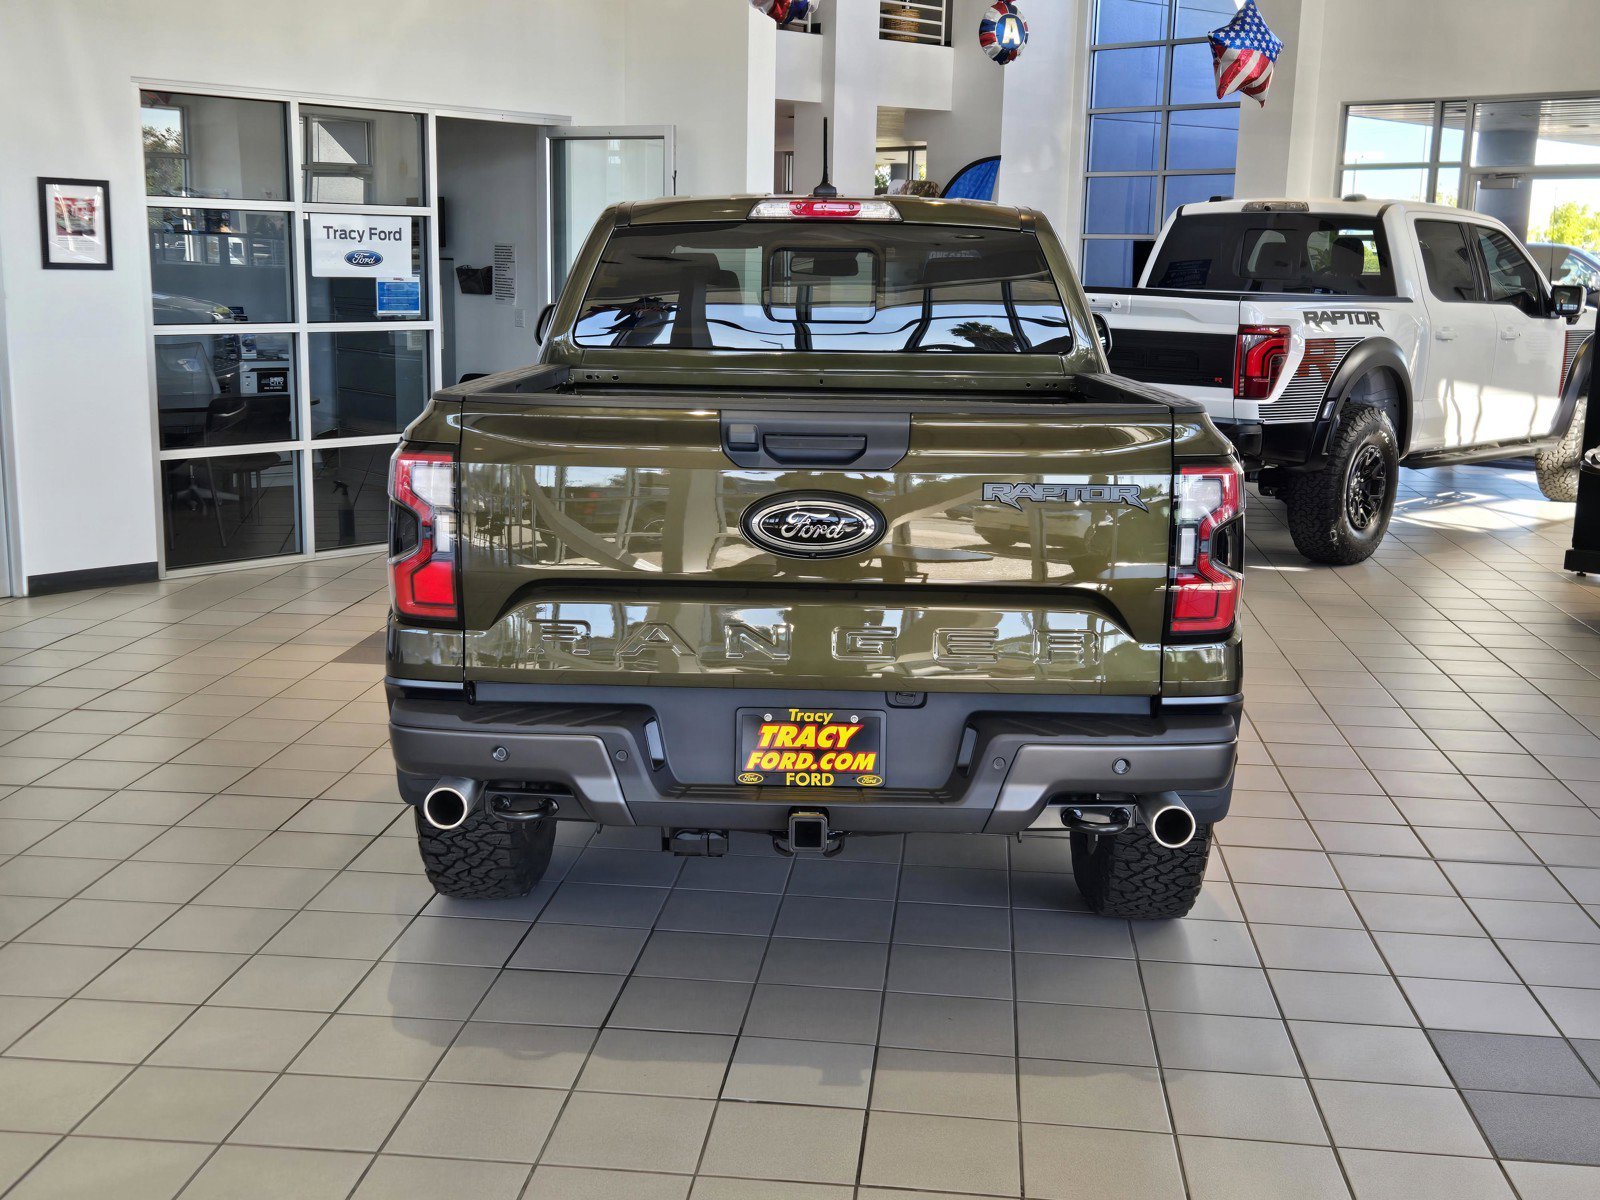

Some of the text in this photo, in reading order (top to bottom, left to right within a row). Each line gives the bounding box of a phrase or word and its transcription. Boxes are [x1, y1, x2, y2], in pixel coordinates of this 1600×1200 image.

[1002, 18, 1021, 45] A
[322, 225, 402, 243] Tracy Ford
[352, 253, 376, 264] Ford
[1303, 311, 1385, 332] RAPTOR
[982, 482, 1150, 514] RAPTOR
[781, 511, 845, 539] Ford
[528, 619, 1101, 665] RANGER
[788, 708, 833, 725] Tracy
[757, 723, 864, 749] TRACY
[744, 751, 877, 772] FORD.COM
[786, 772, 835, 786] FORD
